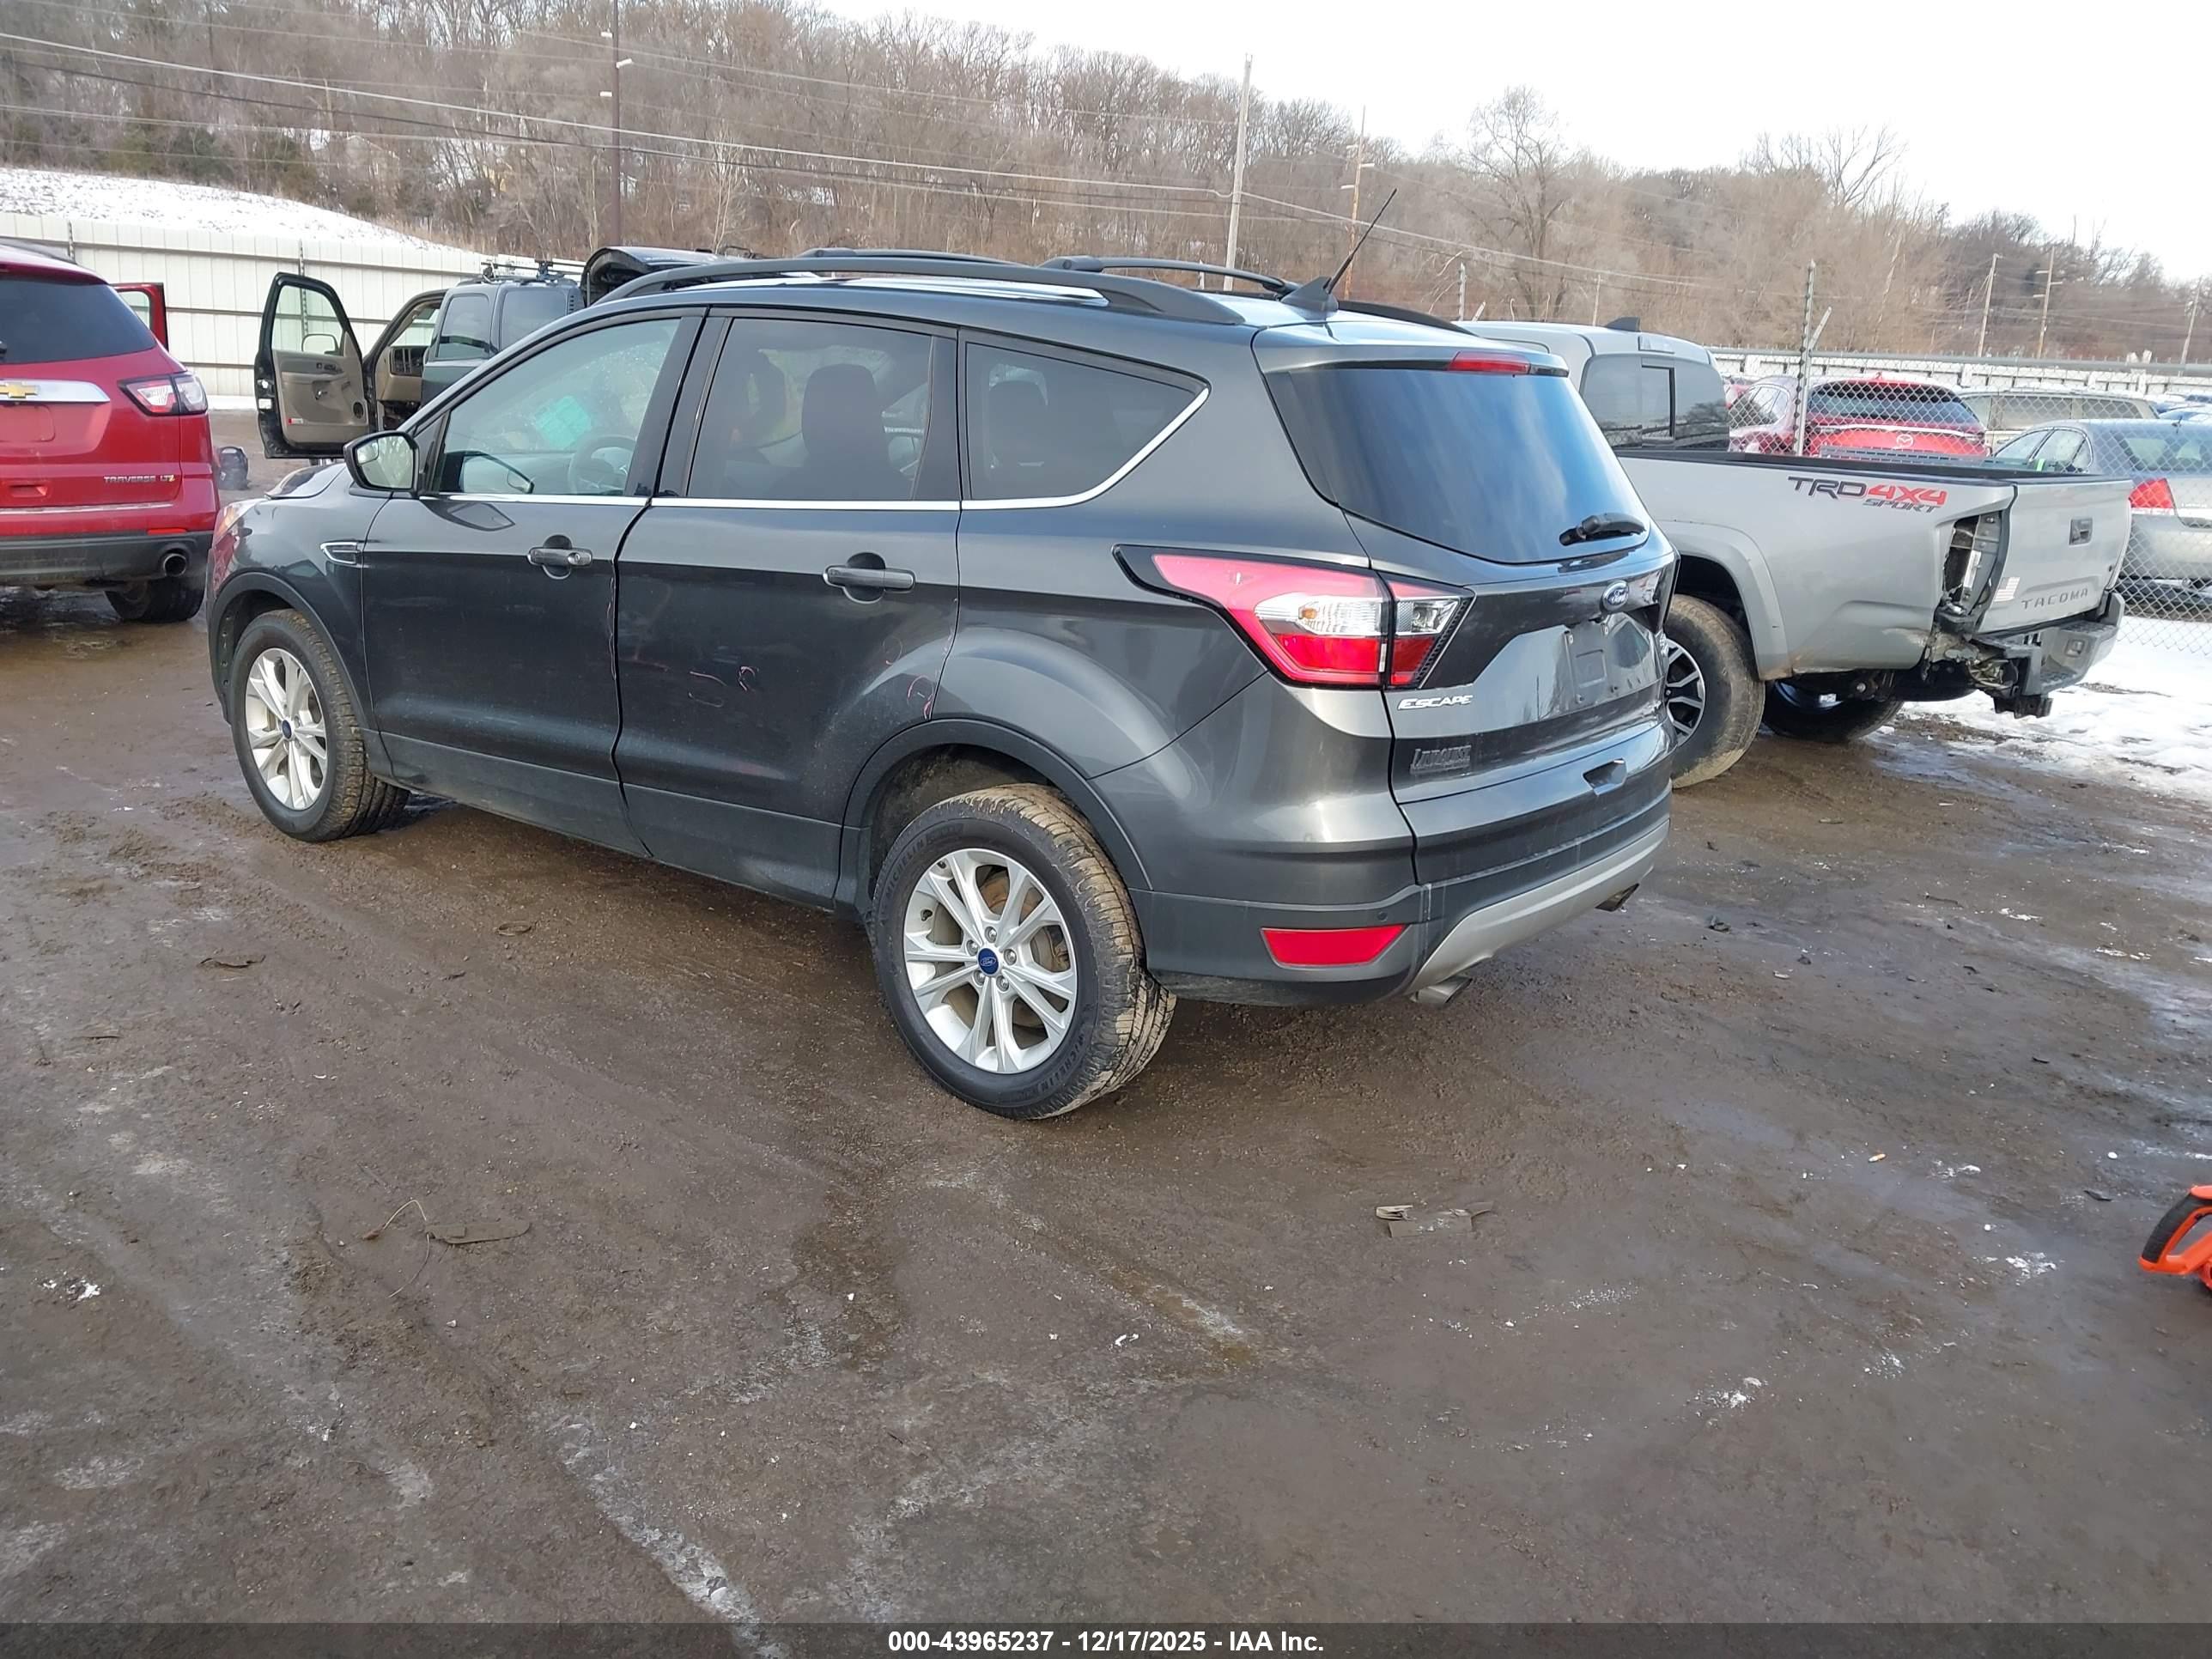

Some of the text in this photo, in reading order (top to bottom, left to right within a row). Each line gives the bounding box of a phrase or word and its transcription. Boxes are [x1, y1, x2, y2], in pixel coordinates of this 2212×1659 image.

[1788, 476, 1868, 500] TRD
[1863, 498, 1942, 514] SPORT
[2021, 587, 2088, 610] TACOMA
[1397, 695, 1474, 711] ESCAPE
